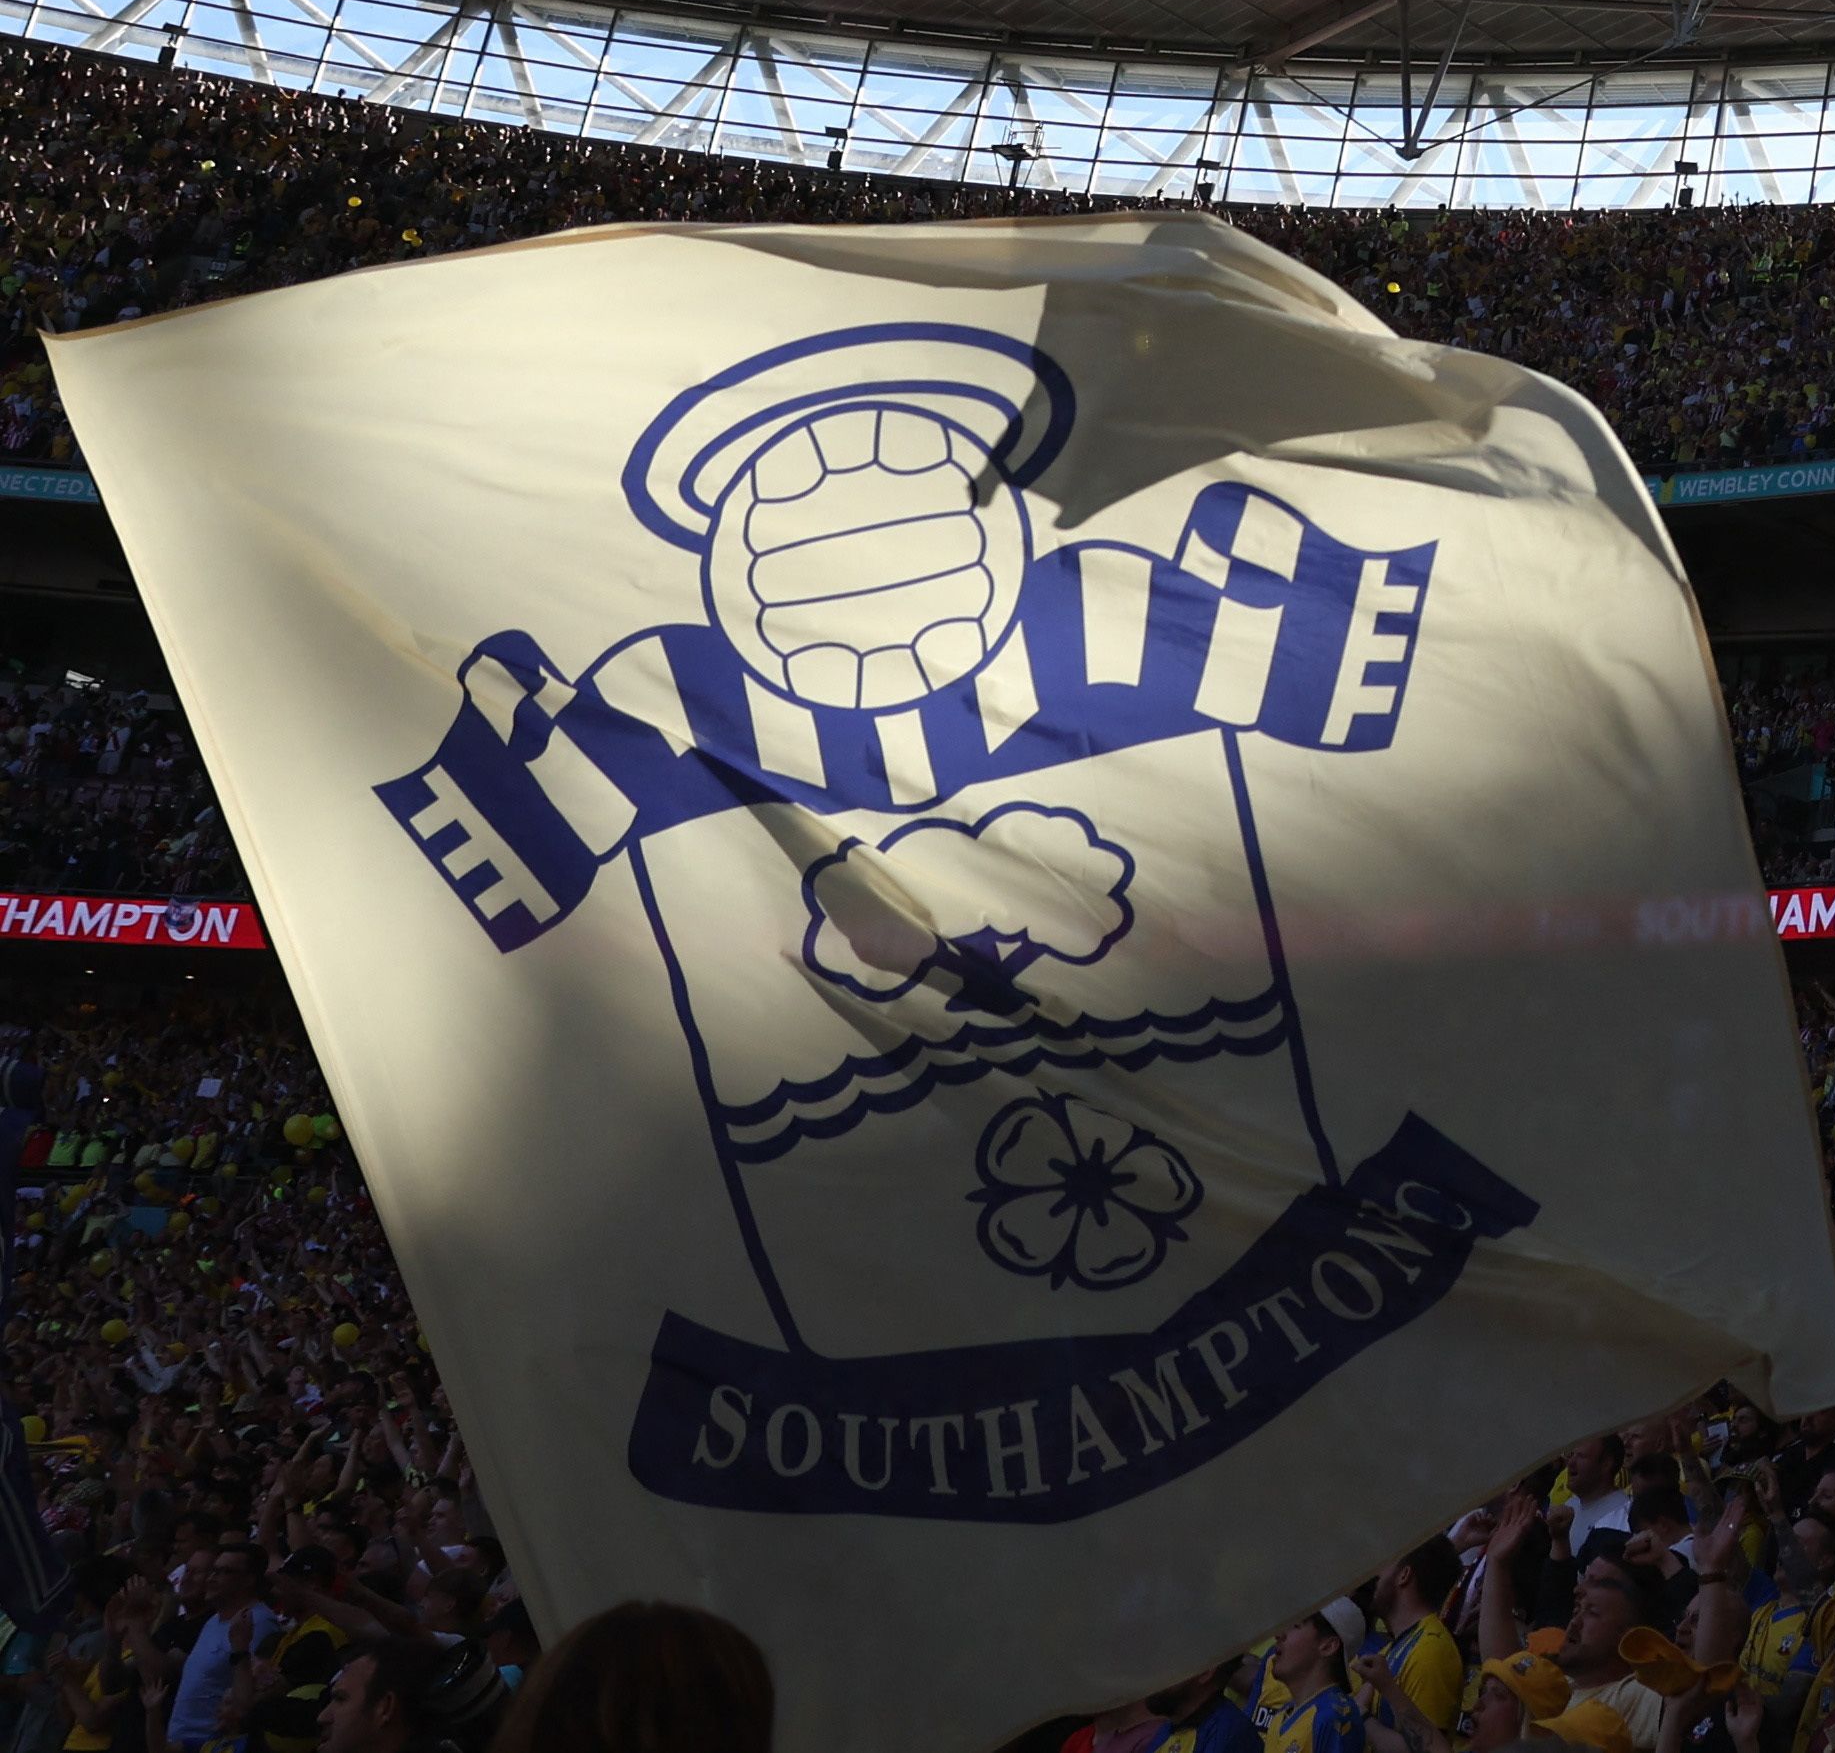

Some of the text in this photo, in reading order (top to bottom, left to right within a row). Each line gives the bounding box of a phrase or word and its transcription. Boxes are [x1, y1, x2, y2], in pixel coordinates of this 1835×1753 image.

[1680, 473, 1773, 497] WEMBLEY
[0, 898, 239, 944] HAMPTON
[691, 1202, 1433, 1499] SOUTHAMPTON
